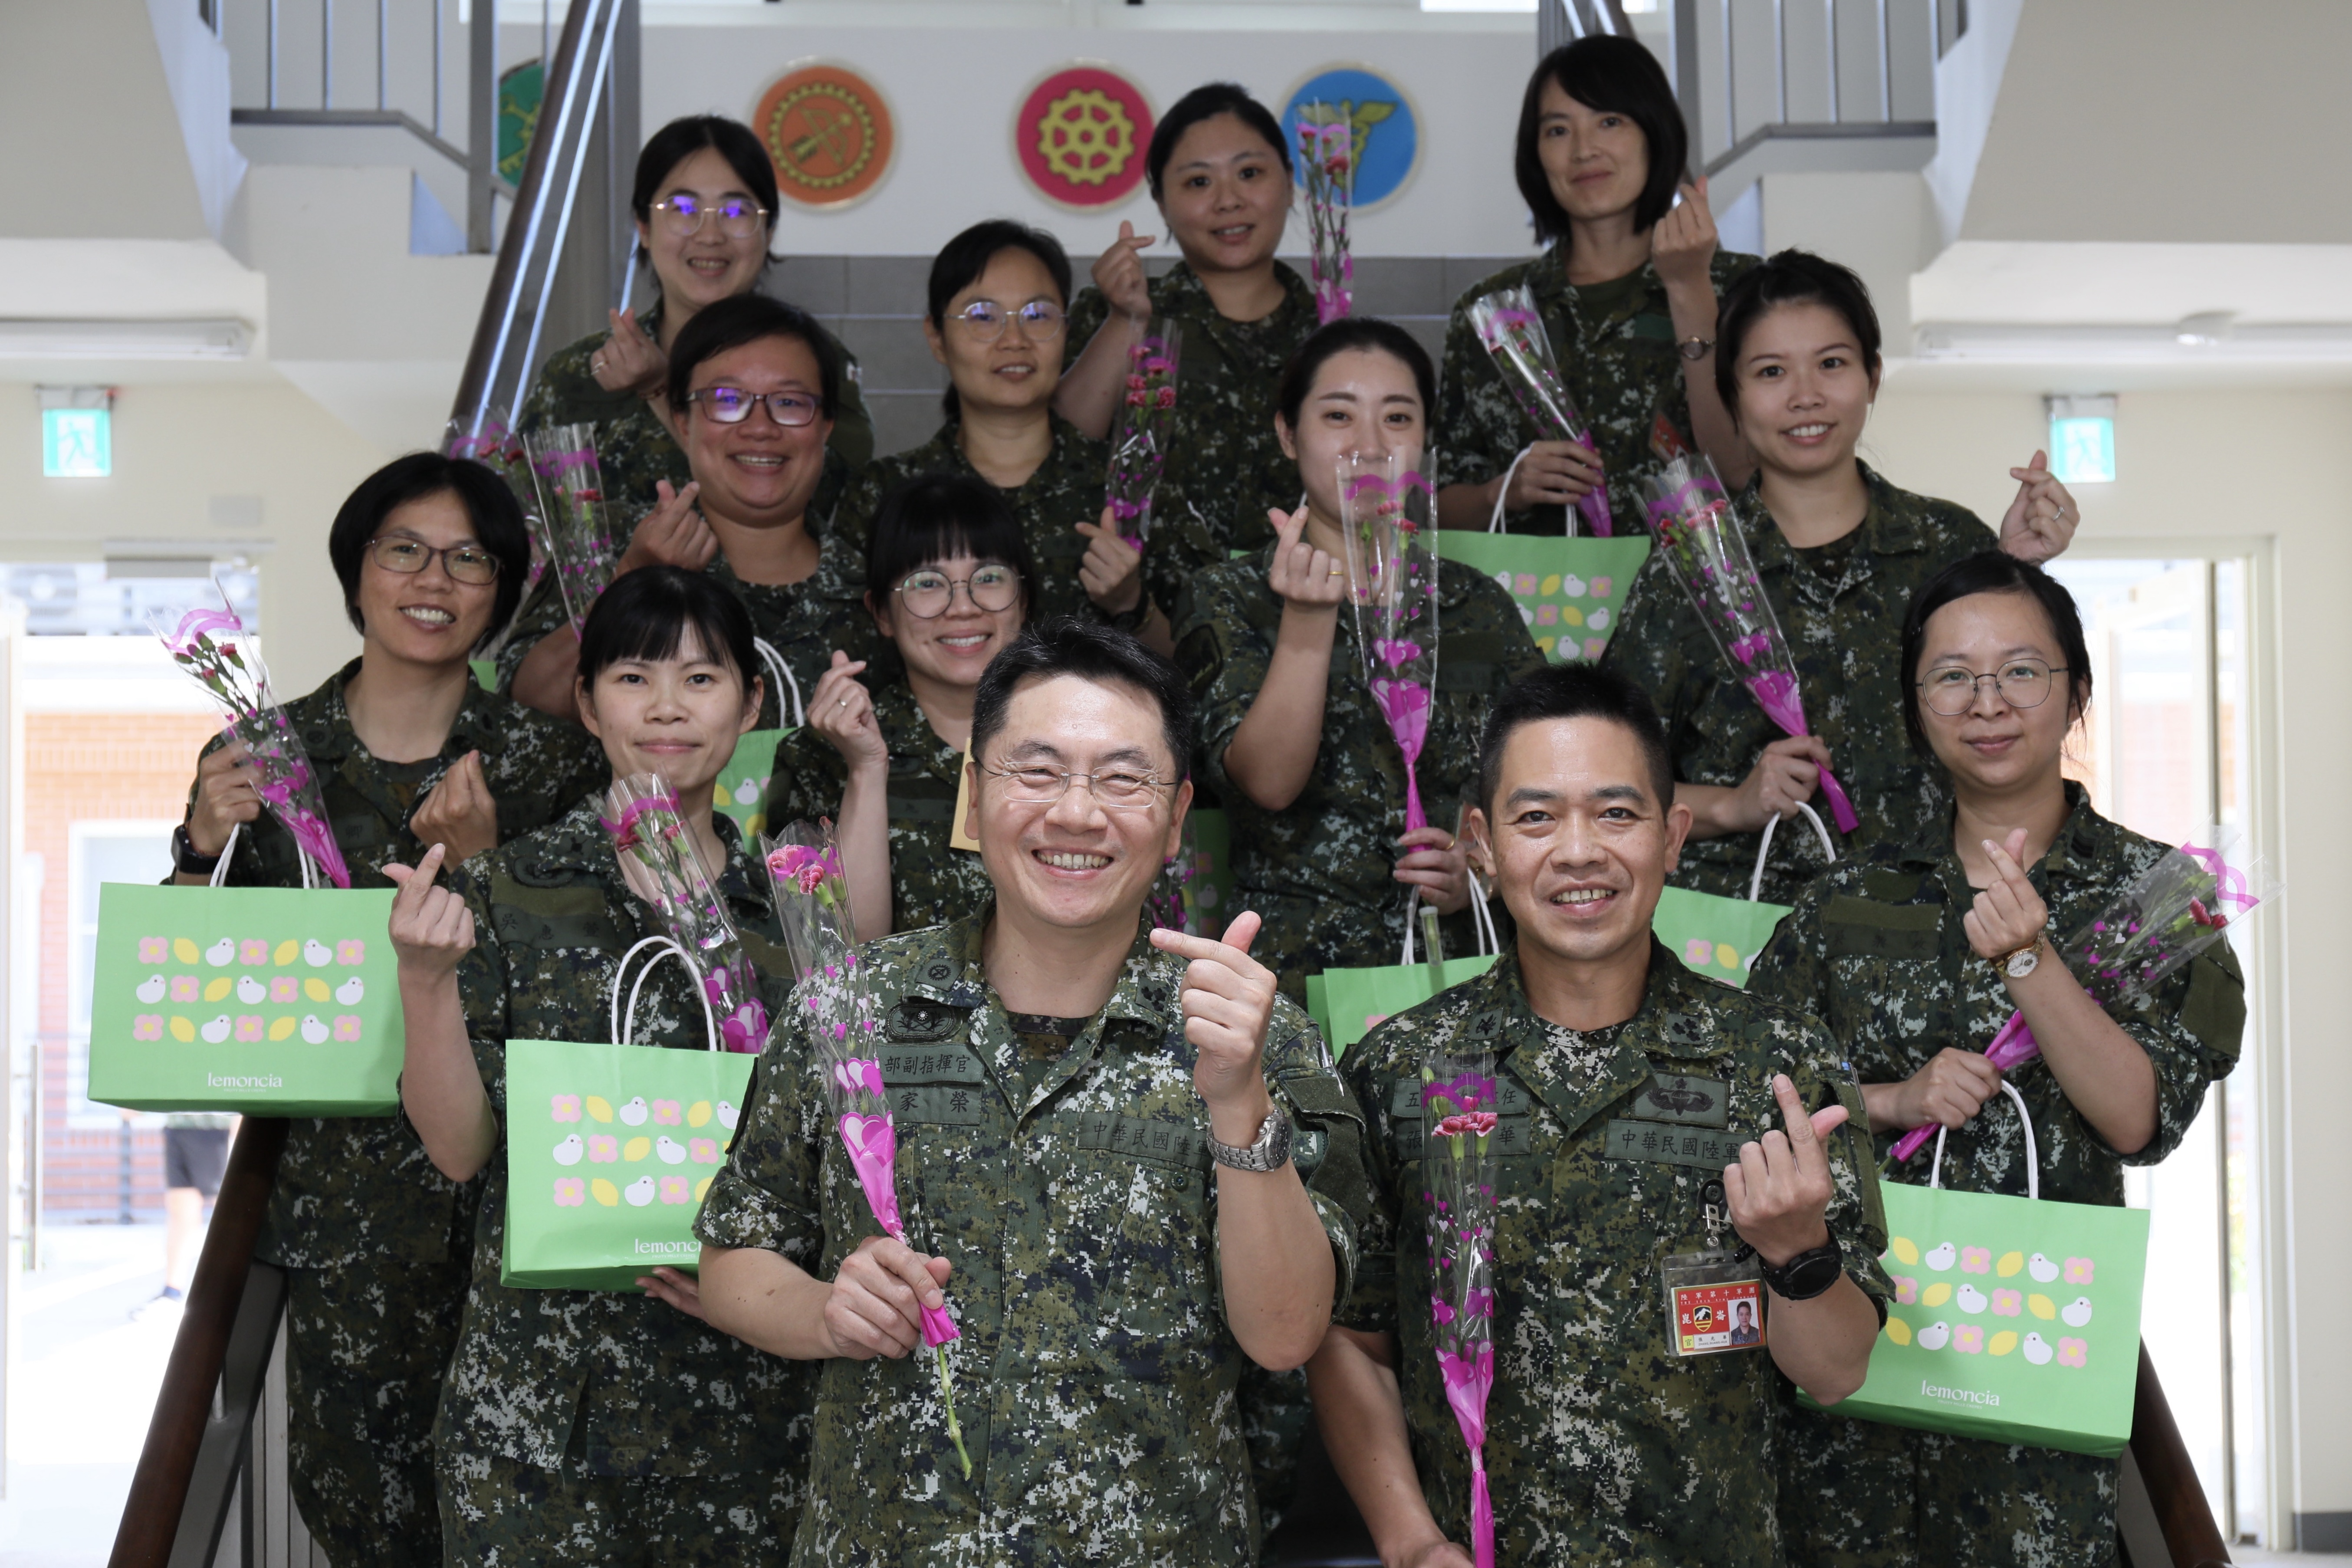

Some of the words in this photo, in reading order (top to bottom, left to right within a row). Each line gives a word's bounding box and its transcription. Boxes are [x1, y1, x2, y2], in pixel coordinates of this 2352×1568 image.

[884, 1053, 971, 1075] 部副指揮官
[208, 1071, 283, 1087] lemoncia
[1094, 1120, 1208, 1161] 中華民國陸軍
[1621, 1129, 1740, 1164] 中華民國陸軍
[1921, 1379, 2000, 1407] lemoncia
